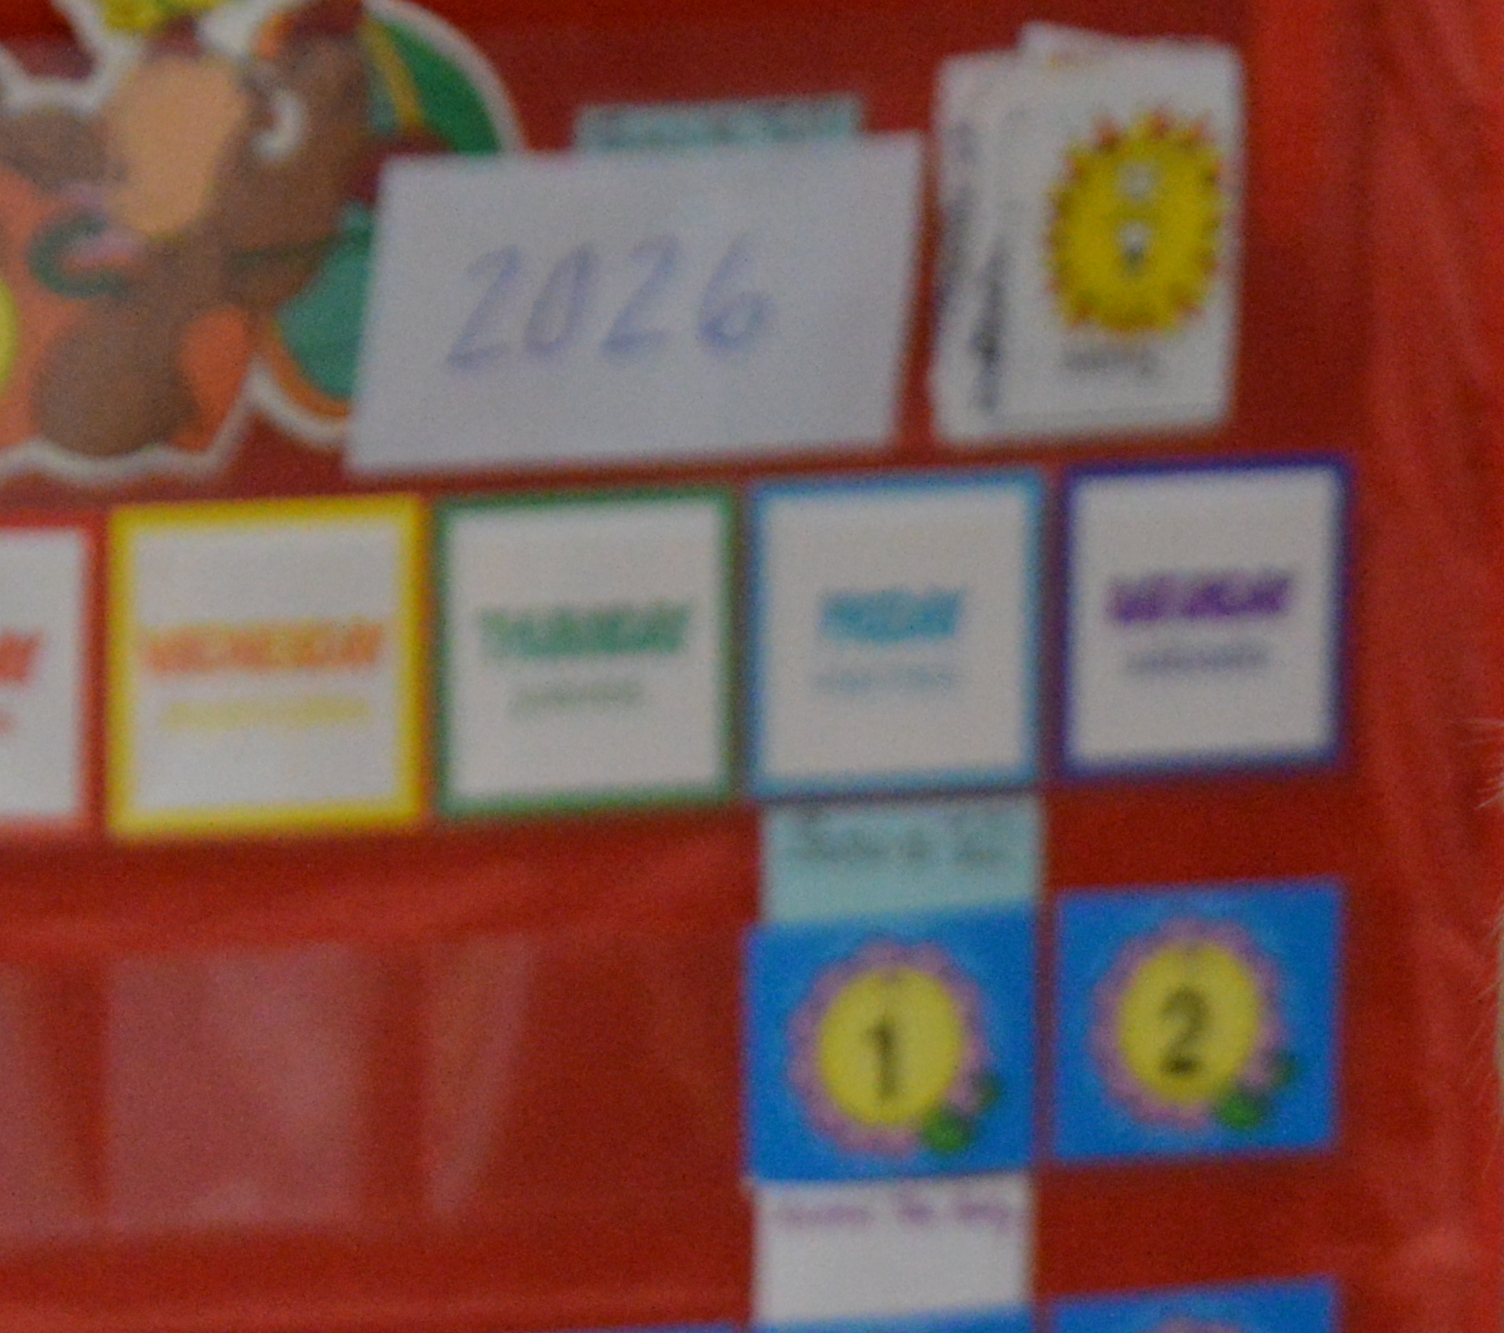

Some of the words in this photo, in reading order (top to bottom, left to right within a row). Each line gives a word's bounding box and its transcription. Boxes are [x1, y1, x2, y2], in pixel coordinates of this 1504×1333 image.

[446, 234, 774, 372] 2026
[863, 1025, 895, 1100] 1
[1160, 988, 1208, 1079] 2
